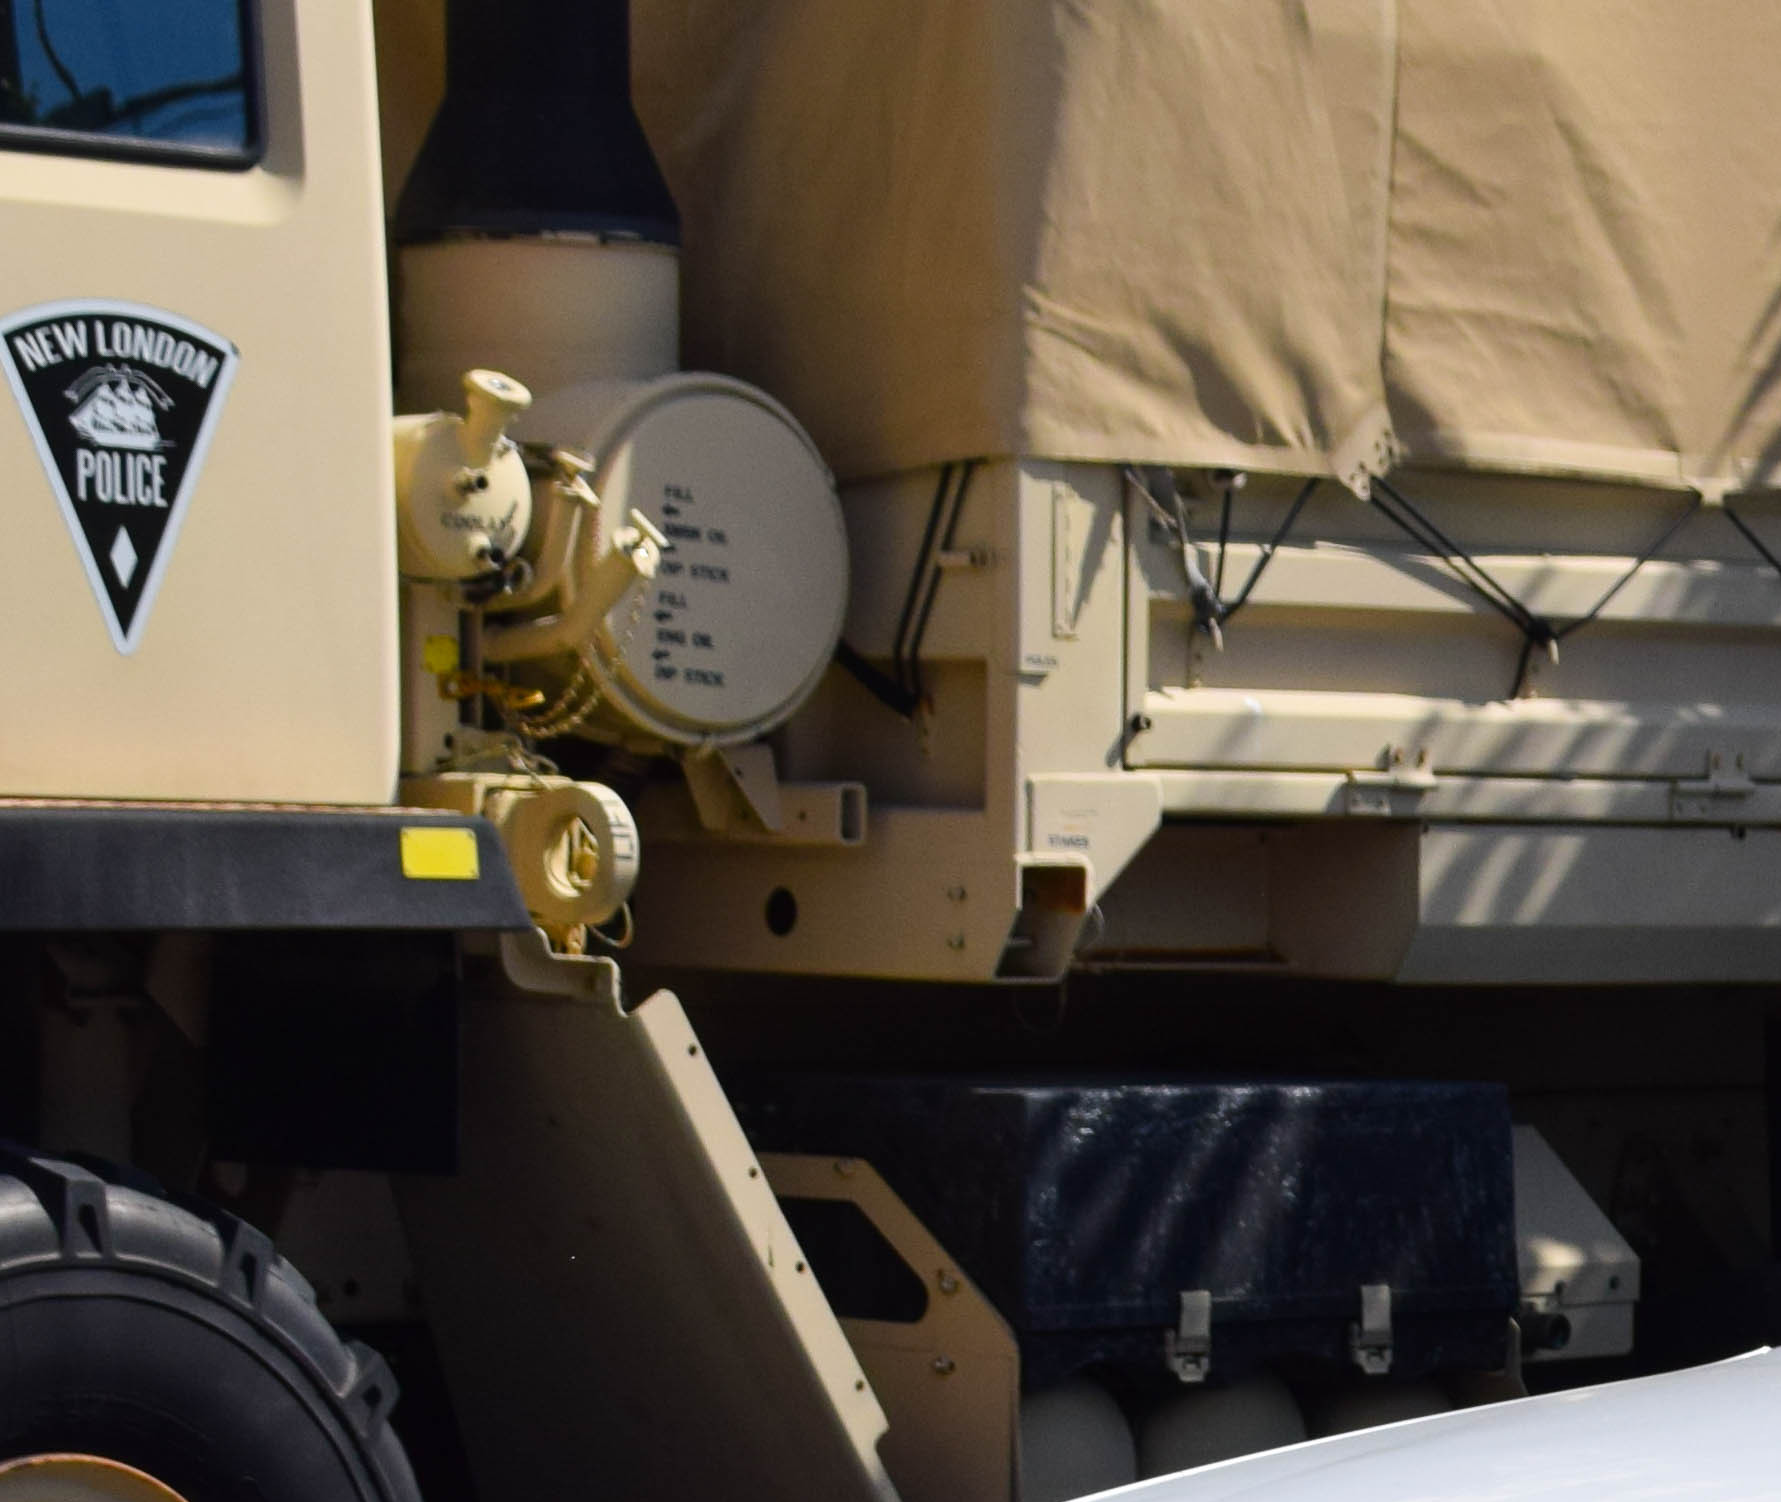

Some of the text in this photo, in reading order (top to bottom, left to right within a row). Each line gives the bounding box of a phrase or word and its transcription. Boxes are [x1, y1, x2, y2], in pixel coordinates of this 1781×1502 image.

[13, 319, 220, 389] NEW LONDON
[76, 448, 168, 508] POLICE
